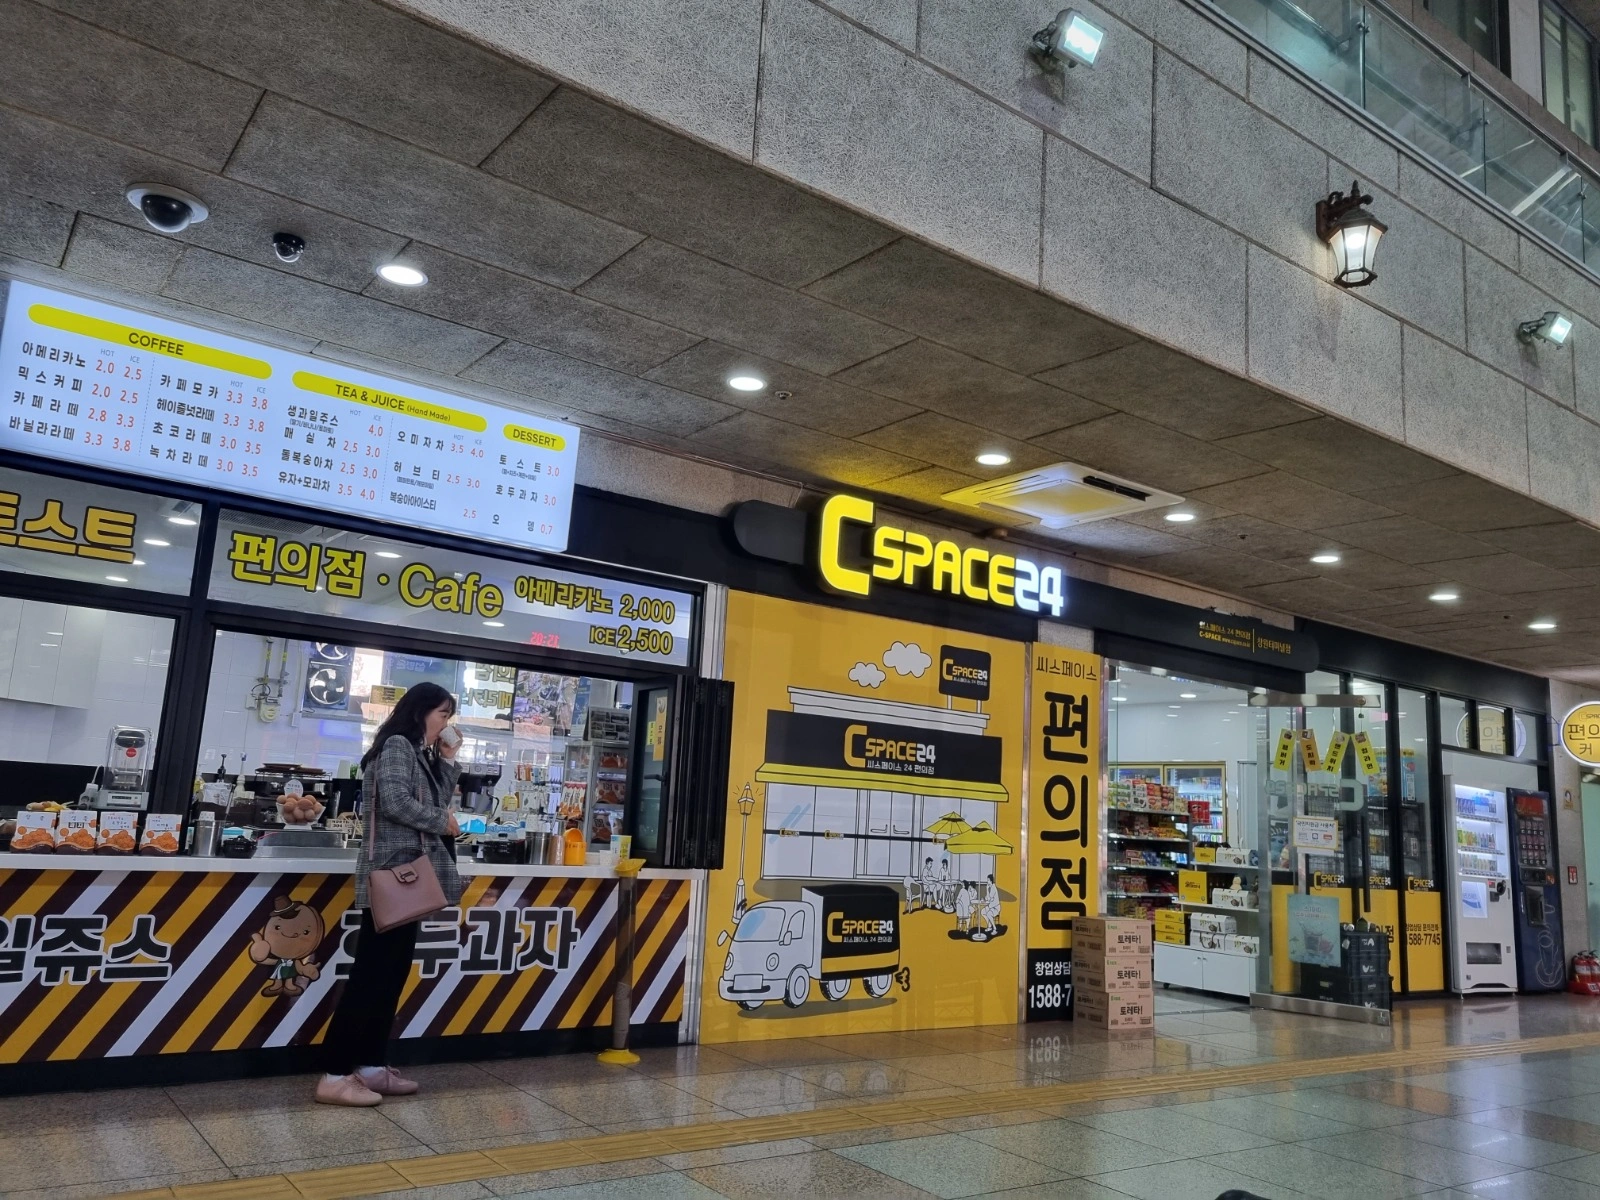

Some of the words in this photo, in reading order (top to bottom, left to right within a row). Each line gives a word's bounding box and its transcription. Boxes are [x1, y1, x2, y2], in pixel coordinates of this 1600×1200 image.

[100, 348, 115, 358] HOT
[129, 355, 141, 364] ICE
[128, 332, 185, 356] COFFEE
[22, 341, 87, 368] 아메리카노
[95, 359, 115, 374] 2.0
[123, 365, 142, 381] 2.5
[18, 365, 84, 392] 믹스커피
[91, 383, 111, 398] 2.0
[119, 389, 139, 404] 2.5
[160, 374, 219, 399] 카페모카
[226, 390, 243, 405] 3.3
[251, 396, 268, 411] 3.8
[230, 379, 244, 388] HOT
[256, 385, 267, 394] ICE
[12, 390, 79, 417] 카페라떼
[87, 407, 107, 422] 2.8
[116, 413, 135, 428] 3.3
[156, 397, 215, 422] 헤이즐넛라떼
[222, 413, 240, 427] 3.3
[247, 418, 265, 433] 3.8
[335, 384, 358, 399] TEA
[360, 391, 369, 402] &
[371, 394, 406, 411] JUICE
[406, 405, 428, 417] (Hand
[429, 410, 451, 422] Made)
[8, 415, 76, 441] 바닐라라떼
[83, 431, 103, 446] 3.3
[112, 437, 131, 452] 3.8
[287, 404, 339, 427] 생과일주스
[368, 424, 384, 437] 4.0
[152, 421, 211, 445] 초코라떼
[219, 435, 237, 450] 3.0
[244, 441, 261, 455] 3.5
[284, 426, 336, 449] 매실차
[343, 440, 358, 453] 2.5
[365, 445, 381, 458] 3.0
[397, 430, 444, 451] 오미자차
[450, 443, 464, 453] 3.5
[470, 448, 484, 458] 4.0
[512, 428, 557, 448] DESSERT
[149, 444, 209, 468] 녹차라떼
[216, 458, 234, 473] 3.0
[241, 463, 258, 477] 3.5
[340, 462, 355, 475] 2.5
[363, 467, 378, 479] 3.0
[393, 461, 440, 481] 허브티
[446, 474, 460, 484] 2.5
[466, 478, 480, 488] 3.0
[499, 454, 541, 473] 토스트
[546, 465, 560, 477] 3.0
[278, 471, 330, 492] 유자+모과차
[338, 483, 353, 496] 3.5
[360, 488, 375, 500] 4.0
[495, 484, 538, 502] 호두과자
[543, 494, 557, 506] 3.0
[389, 491, 437, 511] 복숭아아이스티
[463, 508, 477, 519] 2.5
[540, 523, 553, 535] 0.7
[229, 530, 366, 599] 편의점
[399, 562, 504, 619] Cafe
[514, 575, 614, 615] 아메리카노
[619, 593, 676, 625] 2,000
[589, 625, 617, 646] ICE
[616, 624, 674, 656] 2,500
[1035, 655, 1098, 682] 씨스페이스
[903, 763, 913, 772] 24
[914, 764, 935, 775] 편의점
[1040, 690, 1090, 932] 편의점
[1034, 960, 1072, 978] 창업상담
